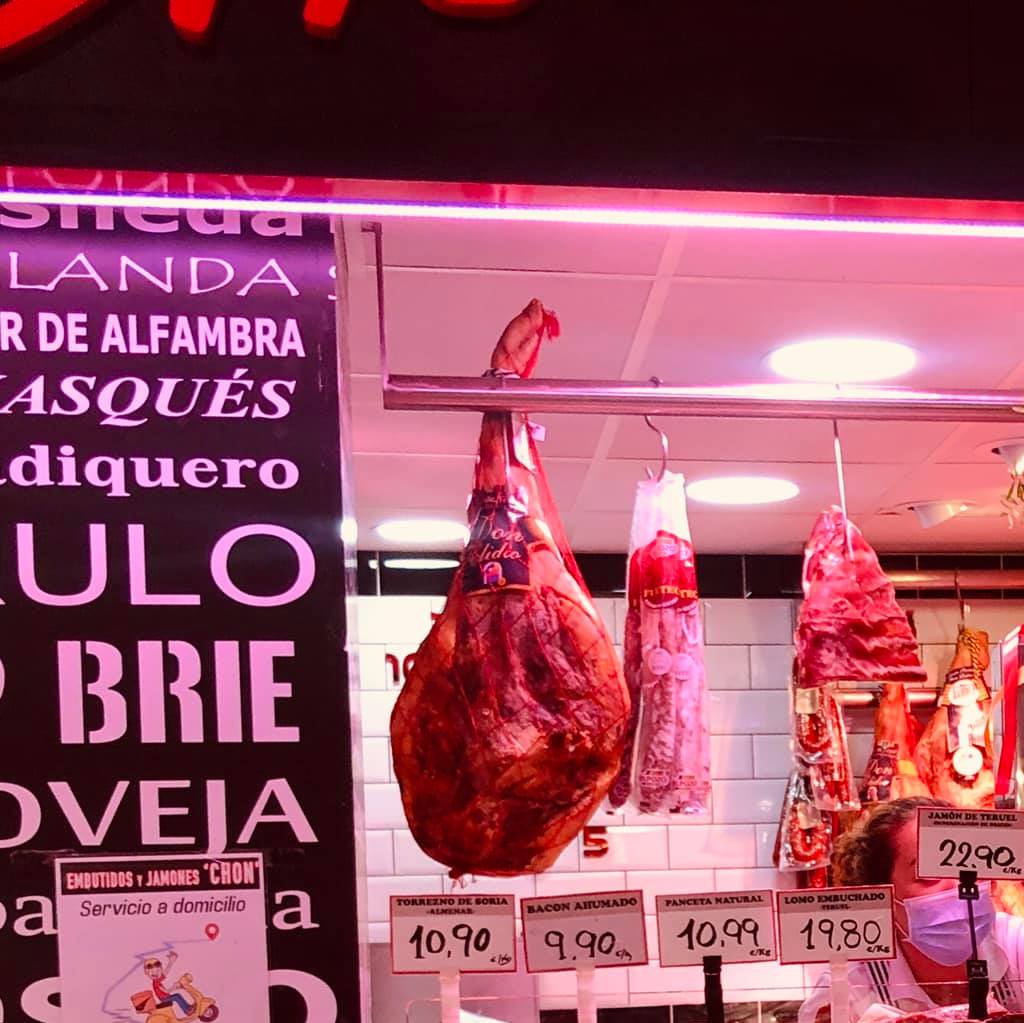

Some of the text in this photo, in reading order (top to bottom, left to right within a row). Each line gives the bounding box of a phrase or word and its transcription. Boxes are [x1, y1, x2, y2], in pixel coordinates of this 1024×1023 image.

[9, 252, 300, 297] LANDA
[38, 312, 88, 353] DE
[101, 314, 306, 358] ALFAMBRA
[0, 445, 299, 497] diquero
[0, 522, 316, 607] ULO
[57, 640, 300, 745] BRIE
[928, 811, 1018, 822] JAMÓN DE TERUEL
[66, 871, 133, 890] EMBUTIDOS
[146, 869, 200, 887] JAMONES
[80, 896, 246, 917] Servicio a domicilio
[396, 898, 508, 906] TORREZNO DE SORIA
[527, 897, 637, 914] BACON AHUMADO
[665, 895, 764, 907] PANCETA NATURAL
[784, 892, 885, 905] LOMO EMBUCHADO
[408, 923, 491, 959] 10,90
[800, 918, 881, 951] 19,80
